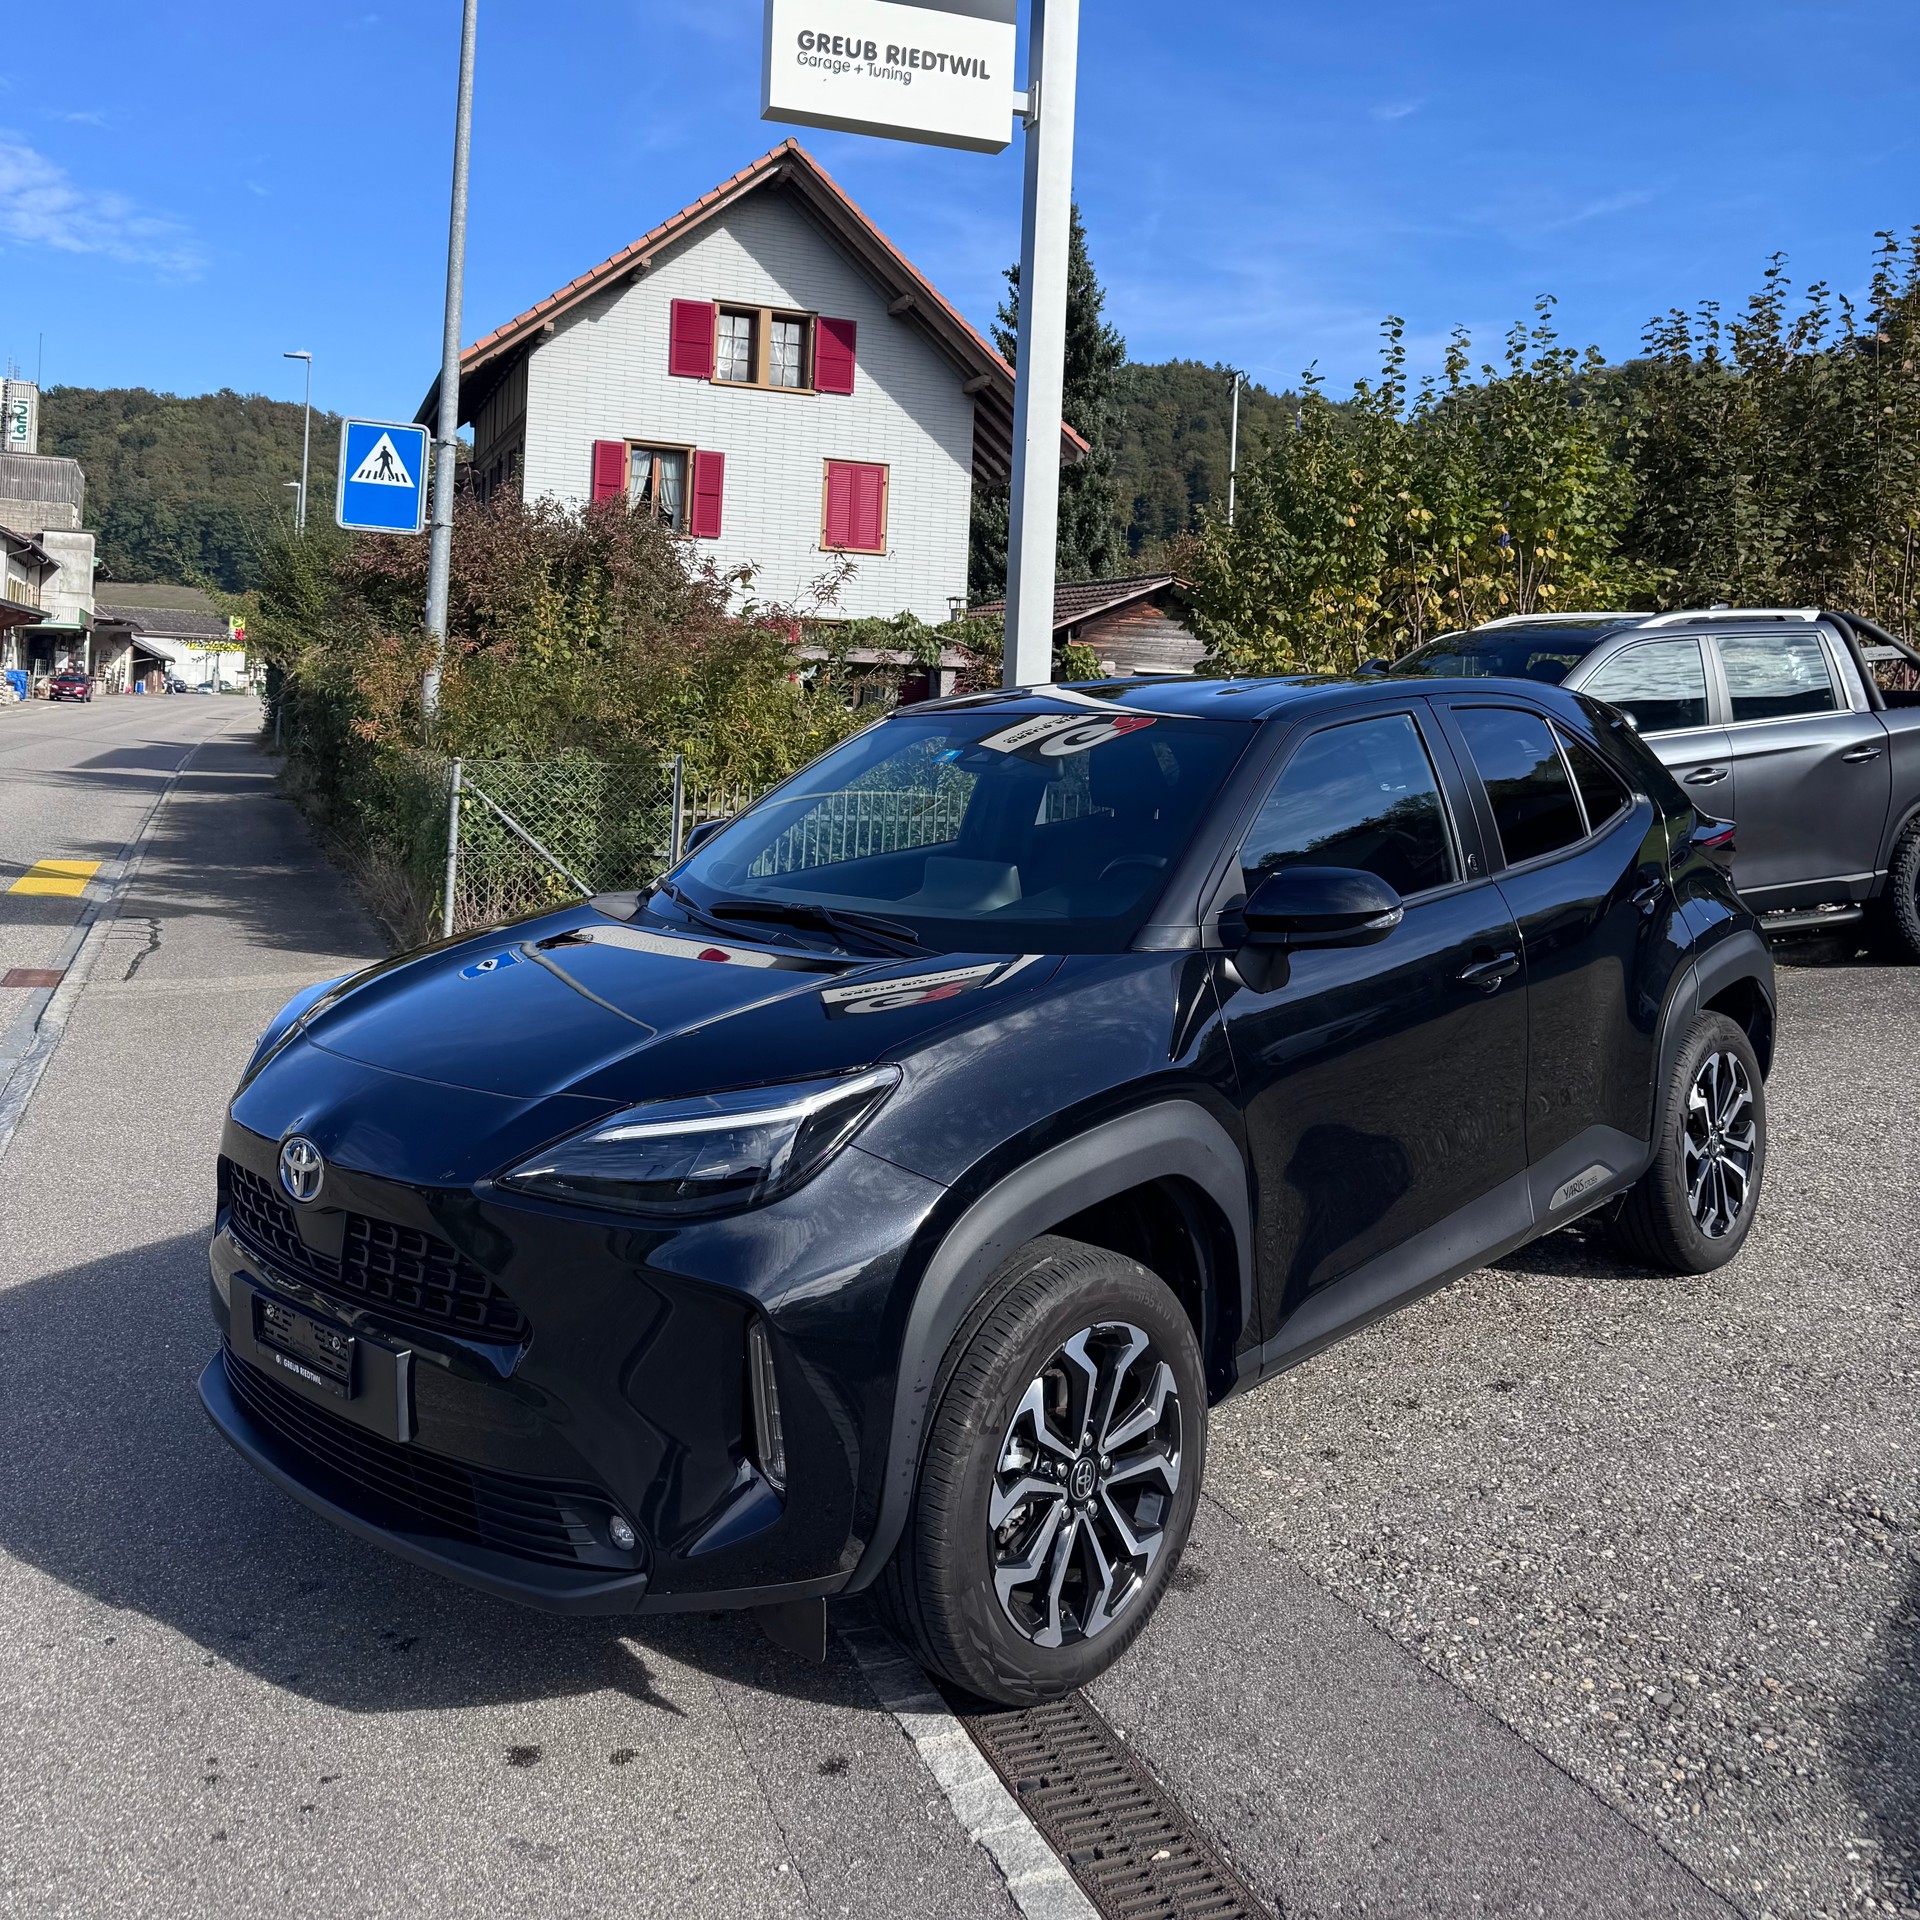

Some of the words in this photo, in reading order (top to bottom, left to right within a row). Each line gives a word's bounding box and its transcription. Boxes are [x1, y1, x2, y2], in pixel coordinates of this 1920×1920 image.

[796, 52, 851, 75] Garage
[866, 62, 912, 85] Tuning
[797, 30, 878, 61] GREUB
[885, 44, 991, 80] RIEDTWIL
